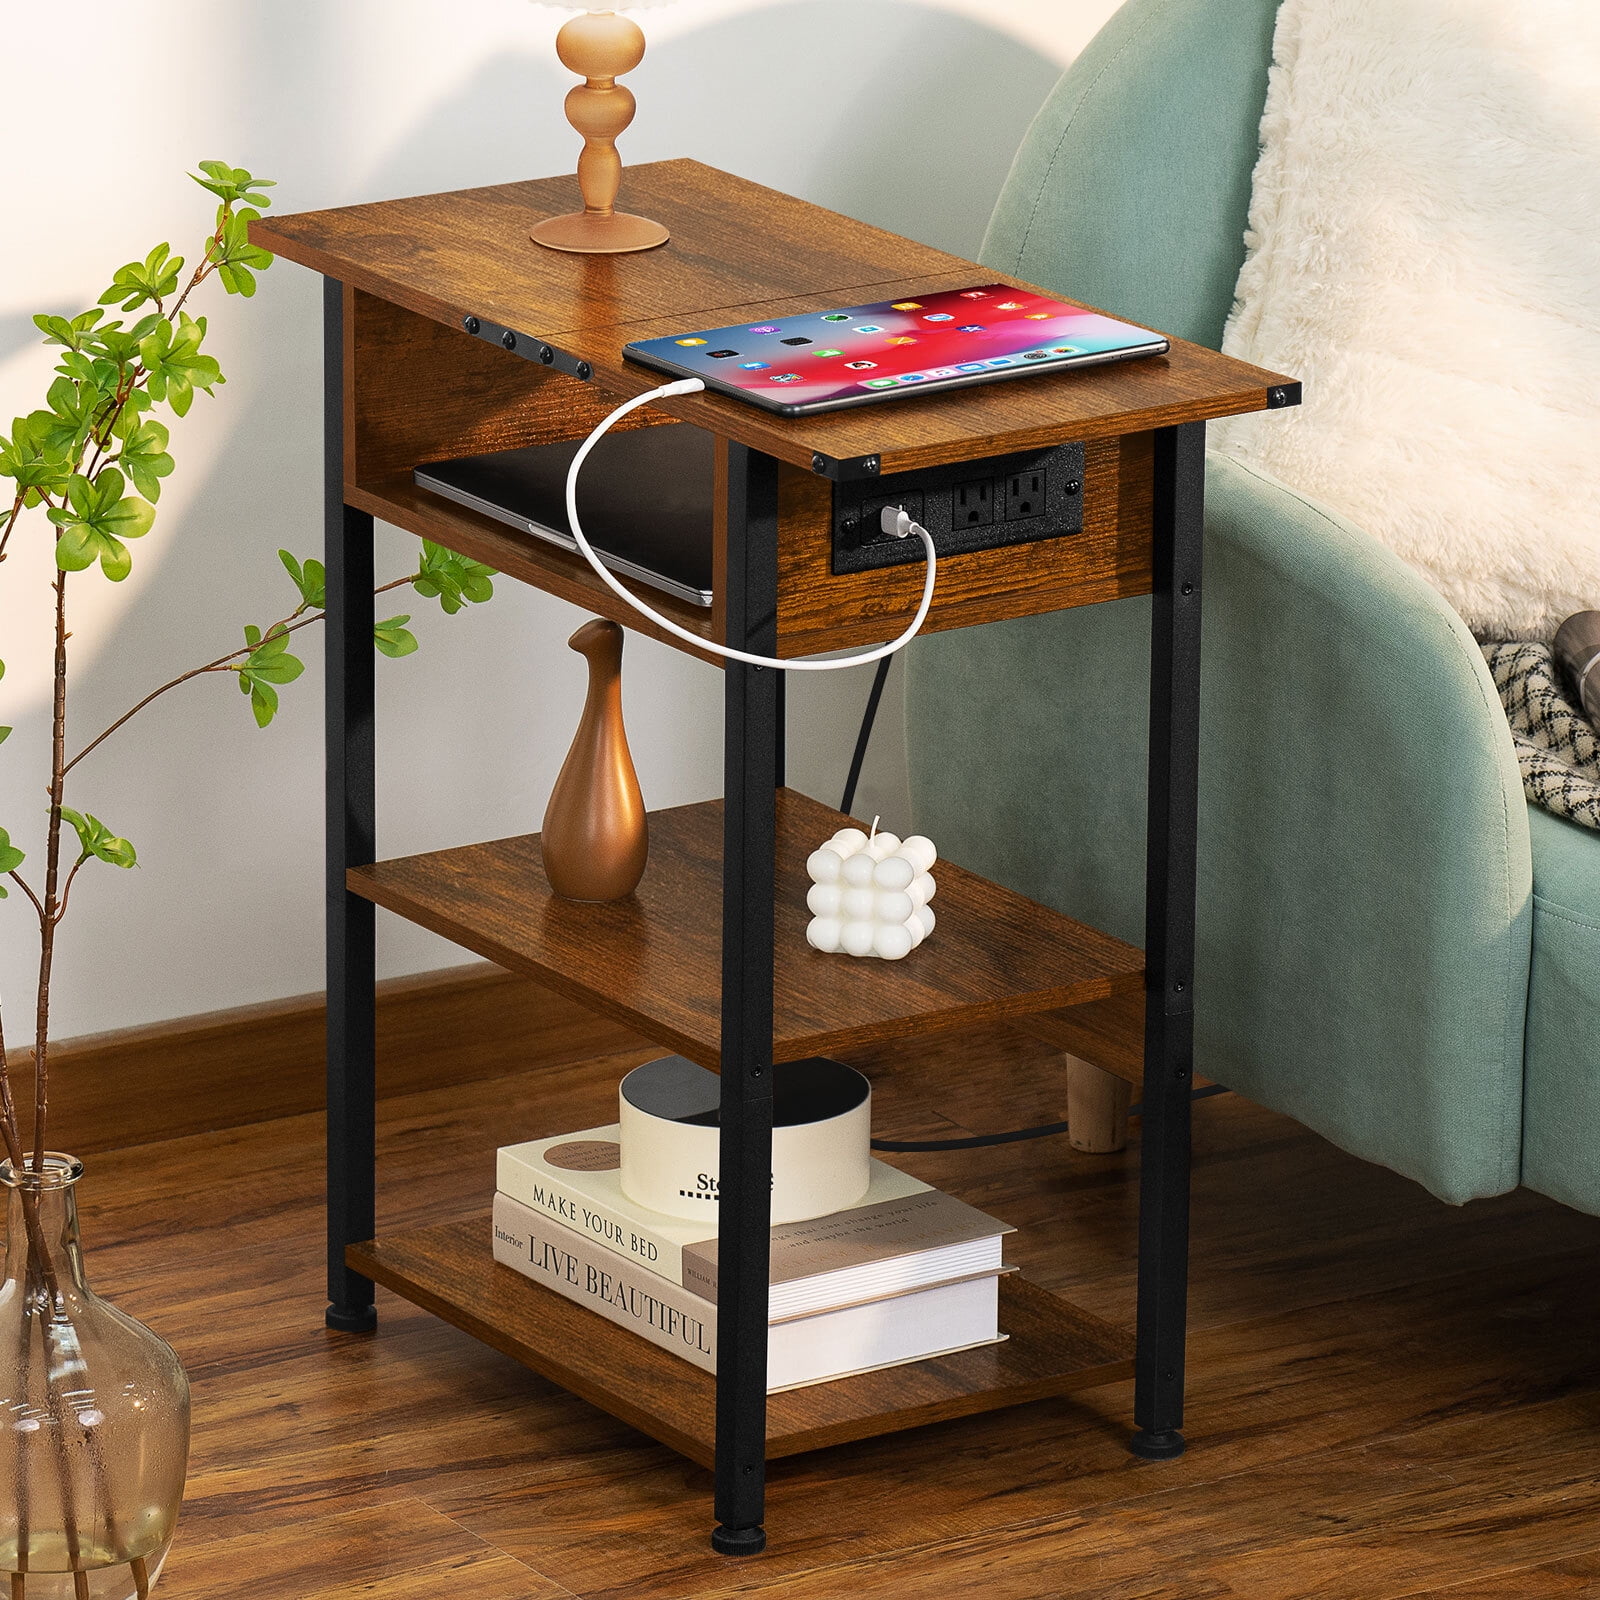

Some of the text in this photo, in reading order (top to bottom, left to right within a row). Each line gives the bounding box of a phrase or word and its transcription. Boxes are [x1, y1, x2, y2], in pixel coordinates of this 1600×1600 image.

[495, 1225, 523, 1249] Interior
[533, 1184, 658, 1262] MAKE YOUR BED
[794, 1228, 817, 1237] that
[820, 1223, 840, 1231] can
[887, 1207, 913, 1218] your
[914, 1201, 938, 1210] life
[813, 1231, 849, 1243] maybe
[852, 1225, 873, 1234] the
[528, 1234, 711, 1355] LIVE BEAUTIFUL
